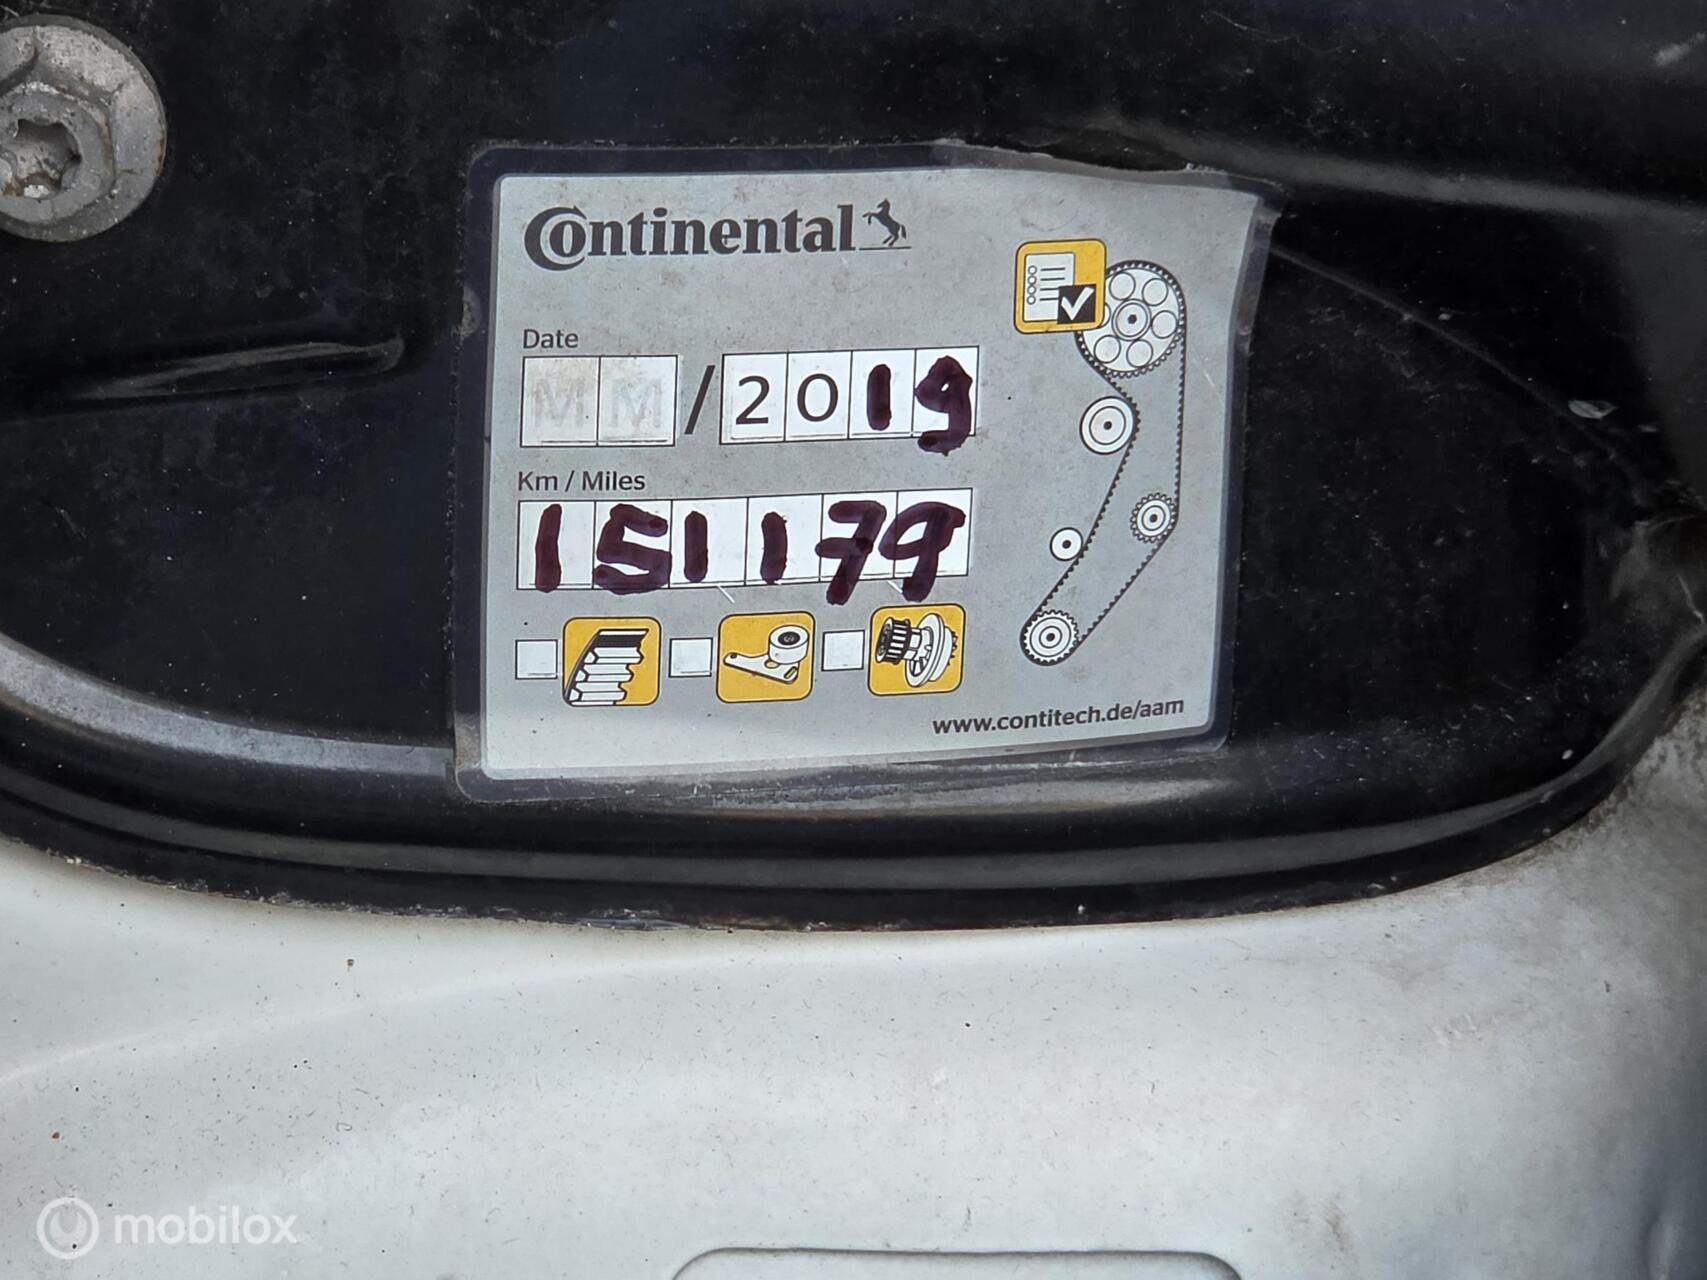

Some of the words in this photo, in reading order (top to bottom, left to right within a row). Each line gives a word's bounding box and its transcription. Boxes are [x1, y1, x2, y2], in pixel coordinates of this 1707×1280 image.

[524, 204, 856, 271] Continental
[522, 328, 579, 350] Date
[735, 355, 974, 456] 2019
[517, 472, 559, 492] Km
[565, 470, 575, 493] /
[581, 471, 646, 492] Miles
[535, 500, 966, 605] 151179
[932, 699, 1184, 734] www.contitech.de/aam
